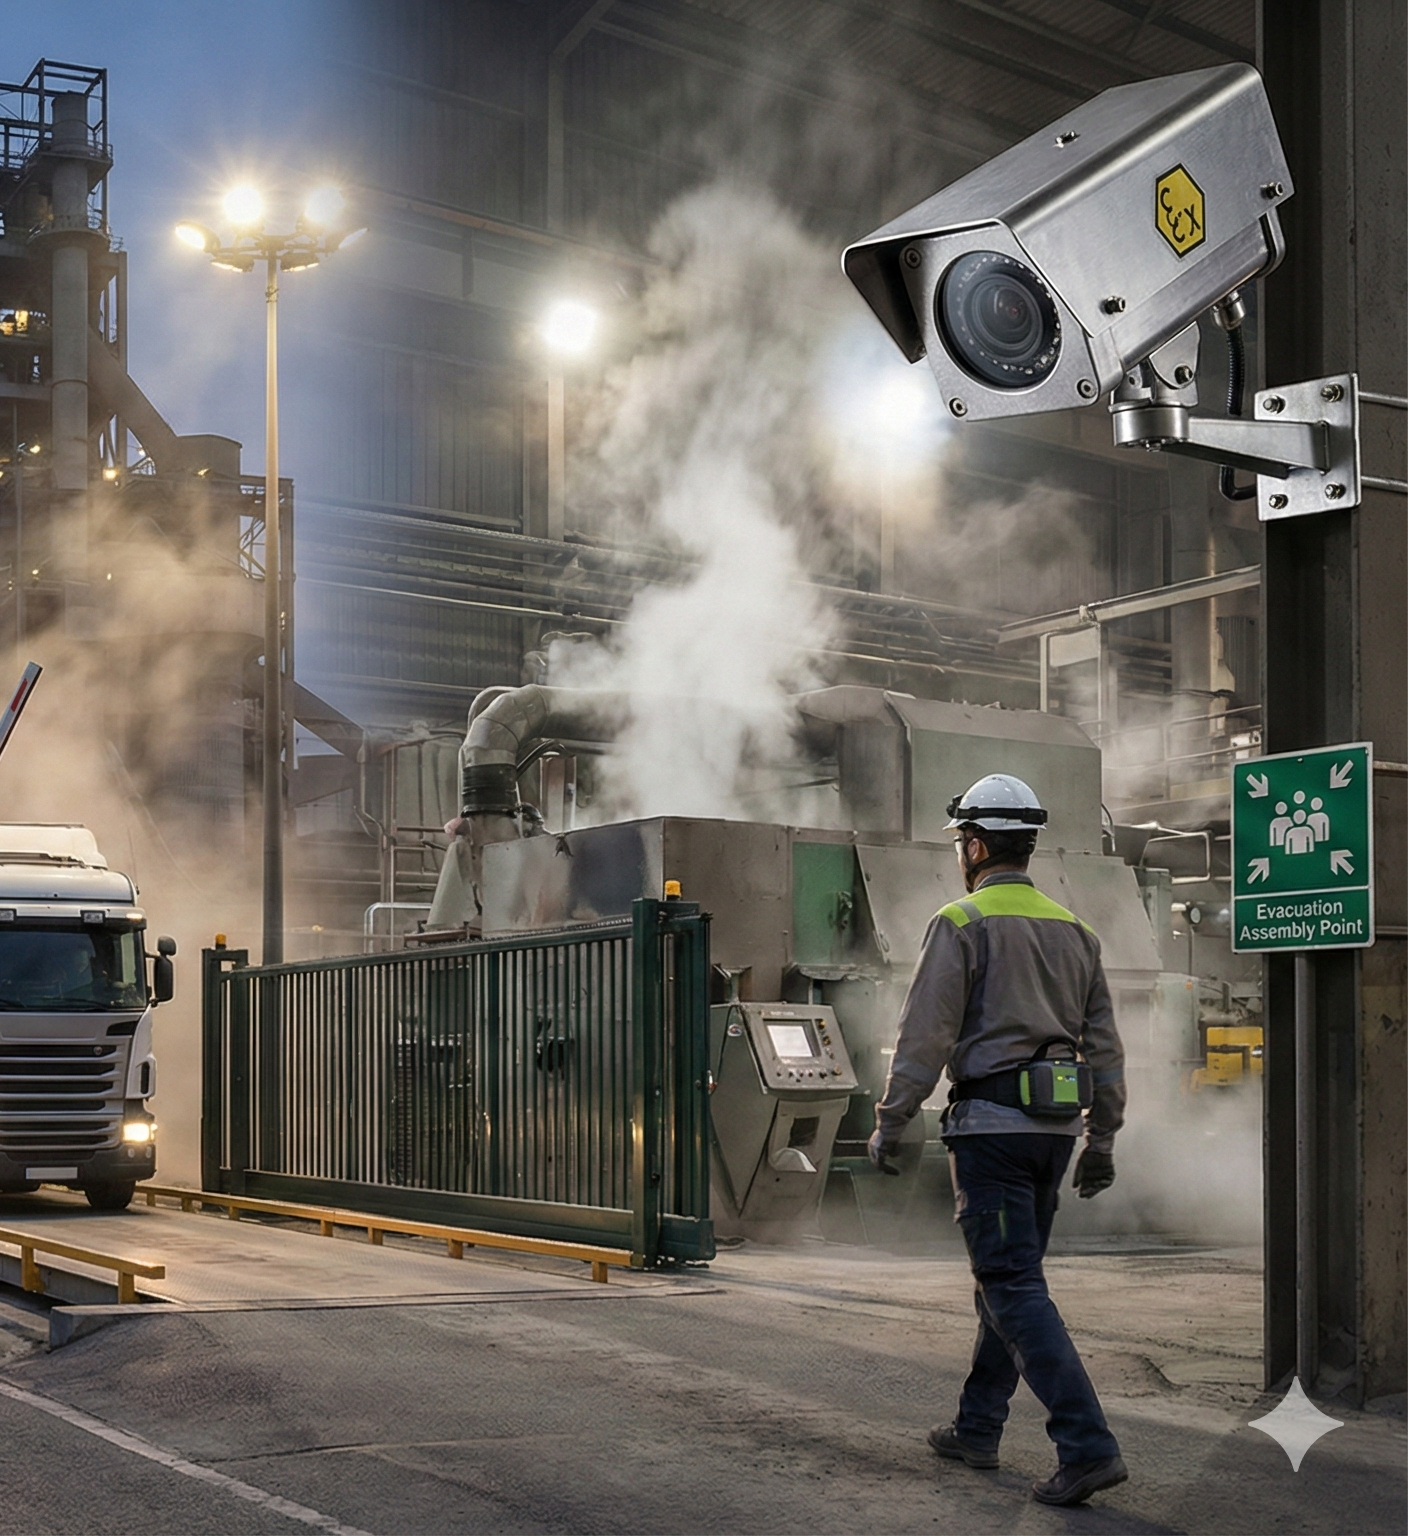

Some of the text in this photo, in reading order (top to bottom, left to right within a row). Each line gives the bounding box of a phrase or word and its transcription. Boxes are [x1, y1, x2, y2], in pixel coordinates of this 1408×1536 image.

[1256, 900, 1343, 920] Evacuation
[1239, 918, 1363, 941] Assembly Point
